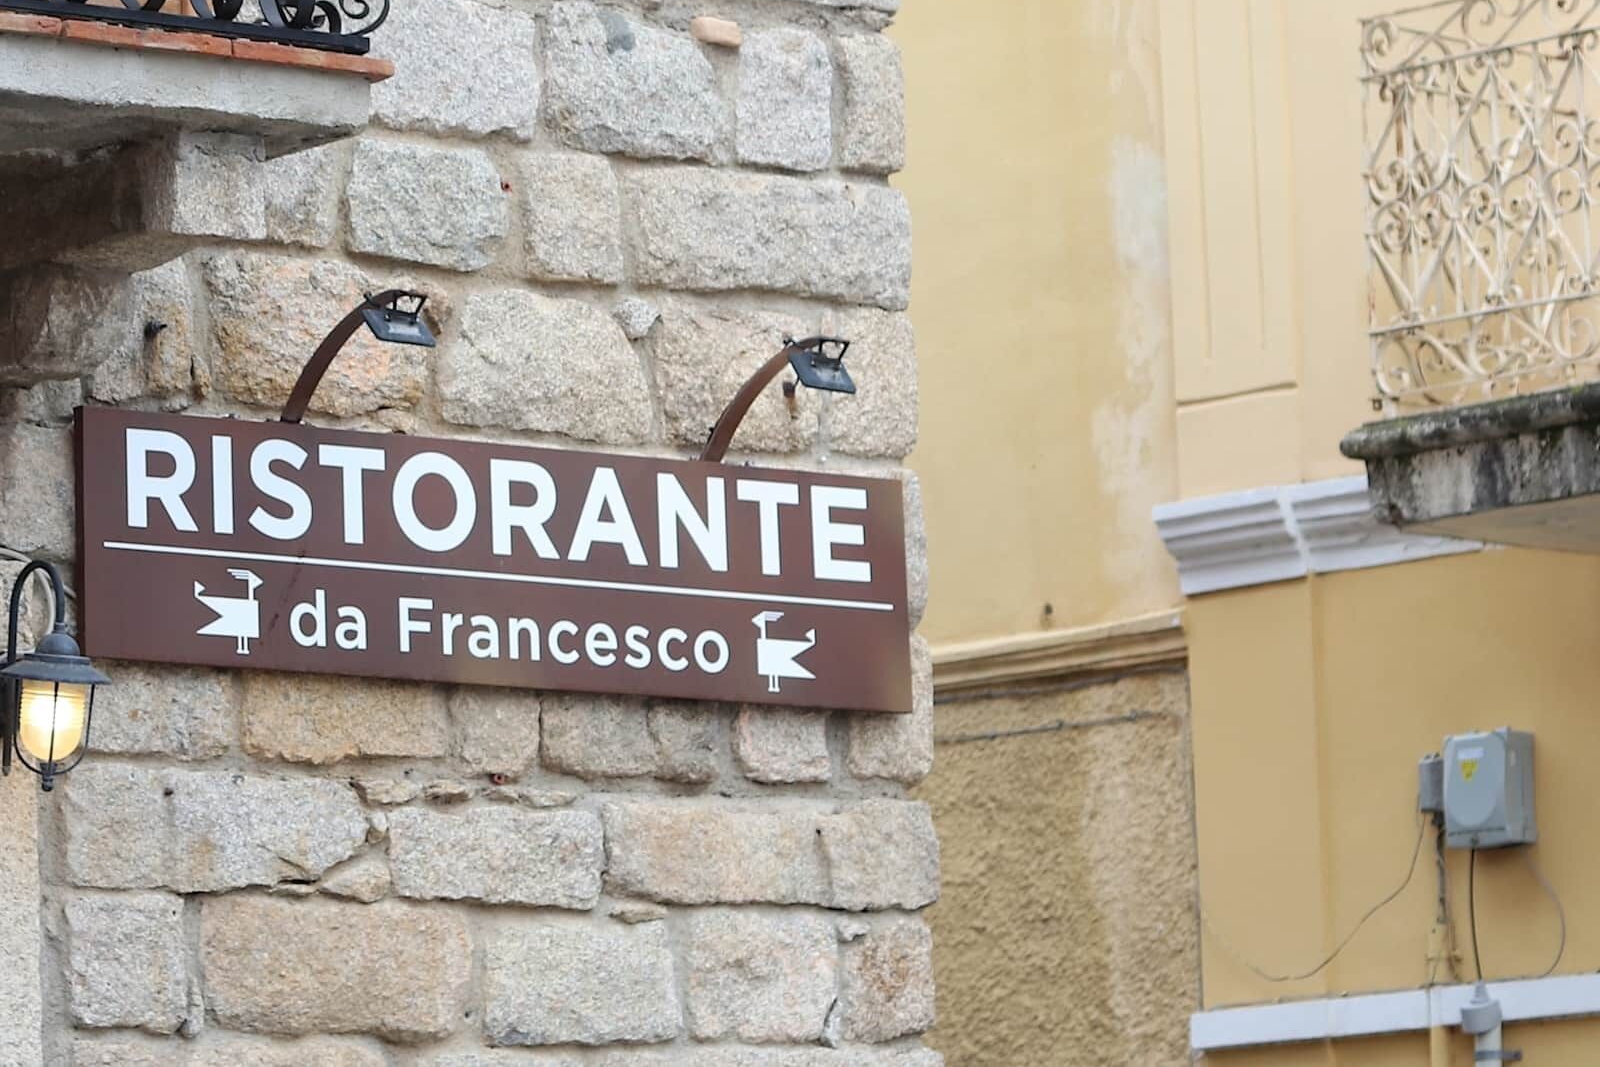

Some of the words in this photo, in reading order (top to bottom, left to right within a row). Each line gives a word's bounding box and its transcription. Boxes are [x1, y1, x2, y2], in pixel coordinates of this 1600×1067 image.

[125, 428, 872, 583] RISTORANTE
[289, 589, 368, 651] da
[398, 597, 730, 674] Francesco
